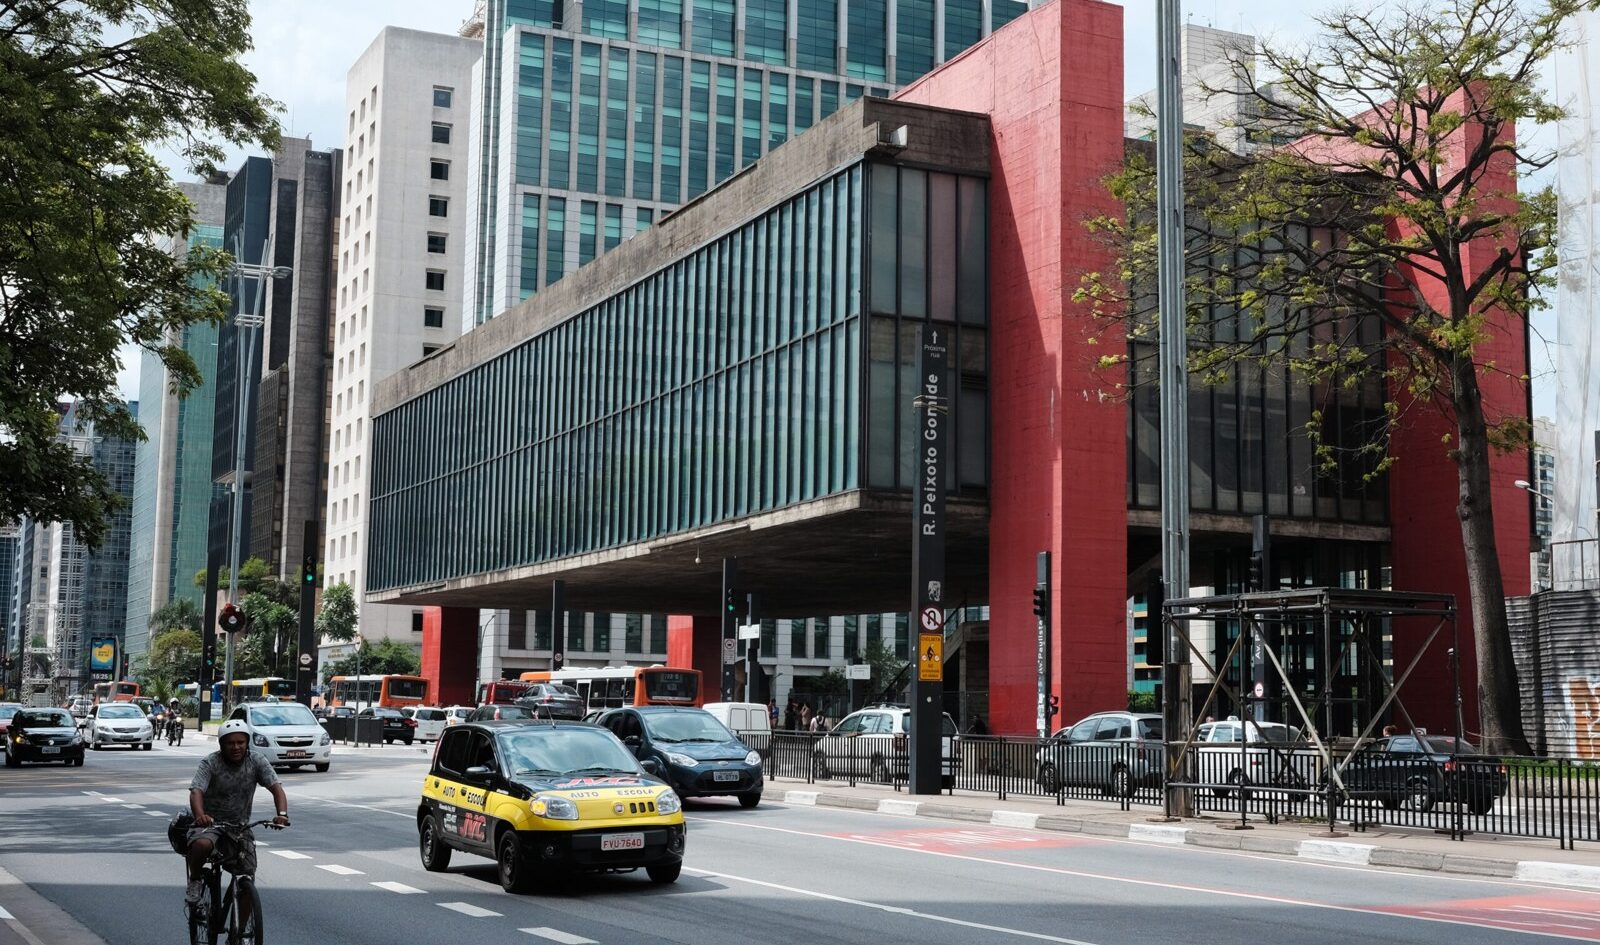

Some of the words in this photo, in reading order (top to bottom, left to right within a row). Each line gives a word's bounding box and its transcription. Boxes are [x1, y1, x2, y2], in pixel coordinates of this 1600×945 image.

[924, 374, 938, 440] Gomide
[923, 447, 937, 515] Peixoto
[923, 520, 936, 535] R.
[443, 785, 456, 798] AUTO
